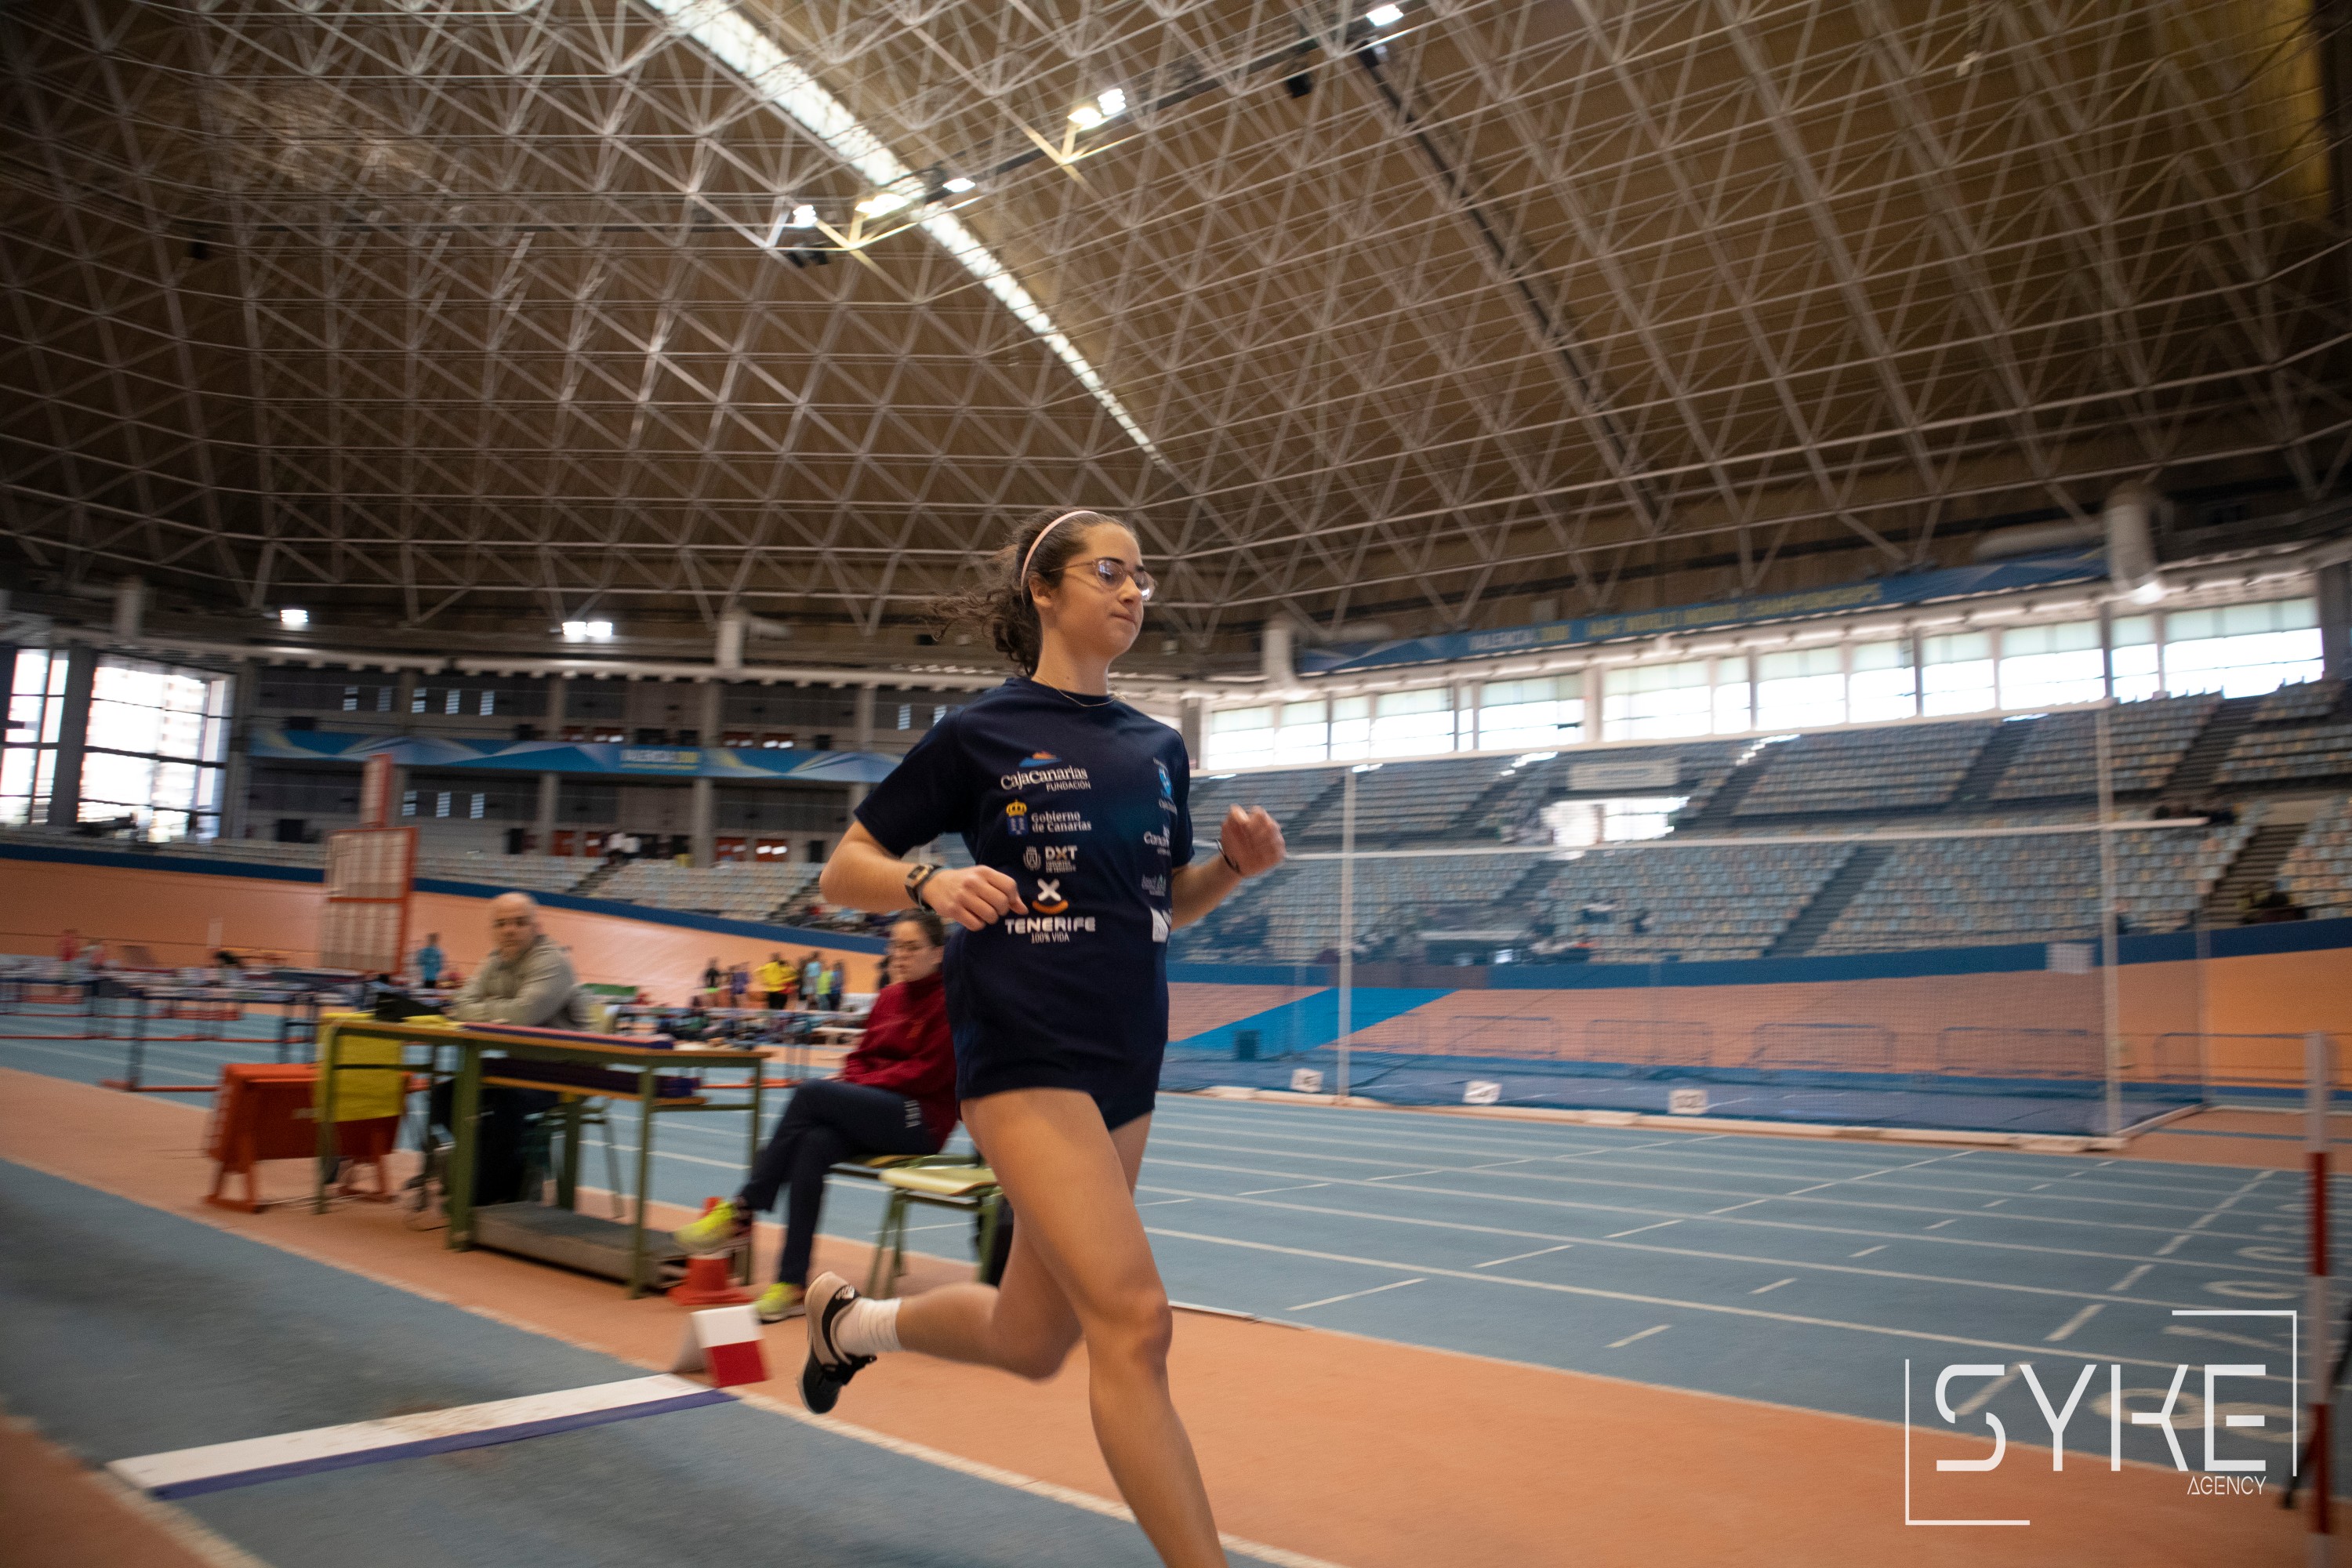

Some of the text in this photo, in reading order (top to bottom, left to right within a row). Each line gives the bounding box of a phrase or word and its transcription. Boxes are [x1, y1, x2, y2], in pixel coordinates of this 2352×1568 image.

[1001, 765, 1088, 790] CajaCanarias
[1031, 811, 1080, 822] Gobierno
[1033, 822, 1091, 833] de Canarias
[1045, 845, 1077, 861] DXT
[1004, 916, 1095, 935] TENERIFE
[1031, 931, 1070, 944] 100% VIDA
